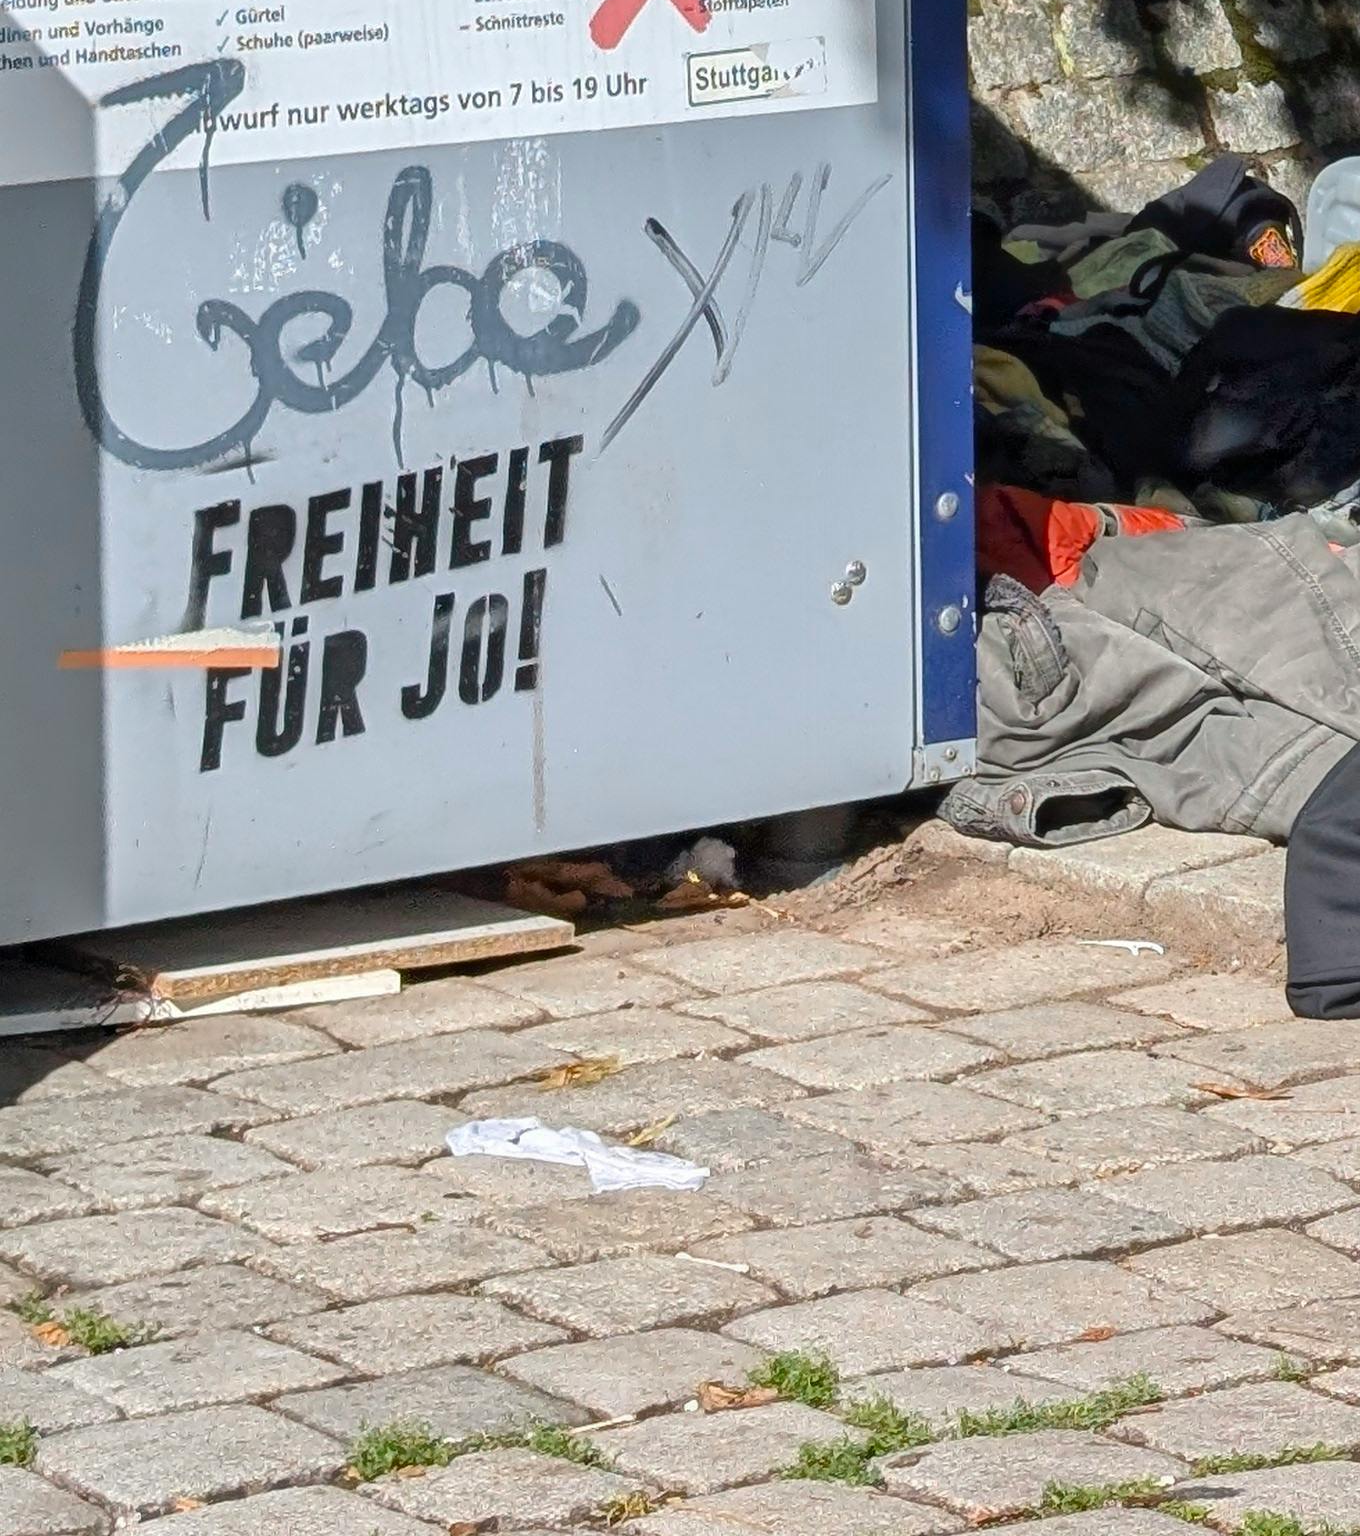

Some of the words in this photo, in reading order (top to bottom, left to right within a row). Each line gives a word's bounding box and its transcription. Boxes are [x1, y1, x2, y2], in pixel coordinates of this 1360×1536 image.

[48, 21, 80, 40] und
[85, 17, 164, 37] Vorhänge
[235, 5, 285, 25] Gürtel
[475, 12, 565, 32] Schnittreste
[237, 32, 293, 52] Schuhe
[298, 23, 389, 50] (paarweise)
[39, 49, 71, 67] und
[76, 42, 182, 64] Handtaschen
[695, 63, 792, 90] Stuttga
[287, 103, 329, 127] nur
[336, 93, 450, 120] werktags
[457, 89, 501, 111] von
[510, 83, 522, 107] 7
[532, 79, 564, 104] bis
[573, 76, 599, 101] 19
[606, 73, 649, 97] Uhr
[182, 434, 584, 632] FREIHEIT
[200, 615, 367, 774] FÜR
[401, 567, 548, 720] JO!
